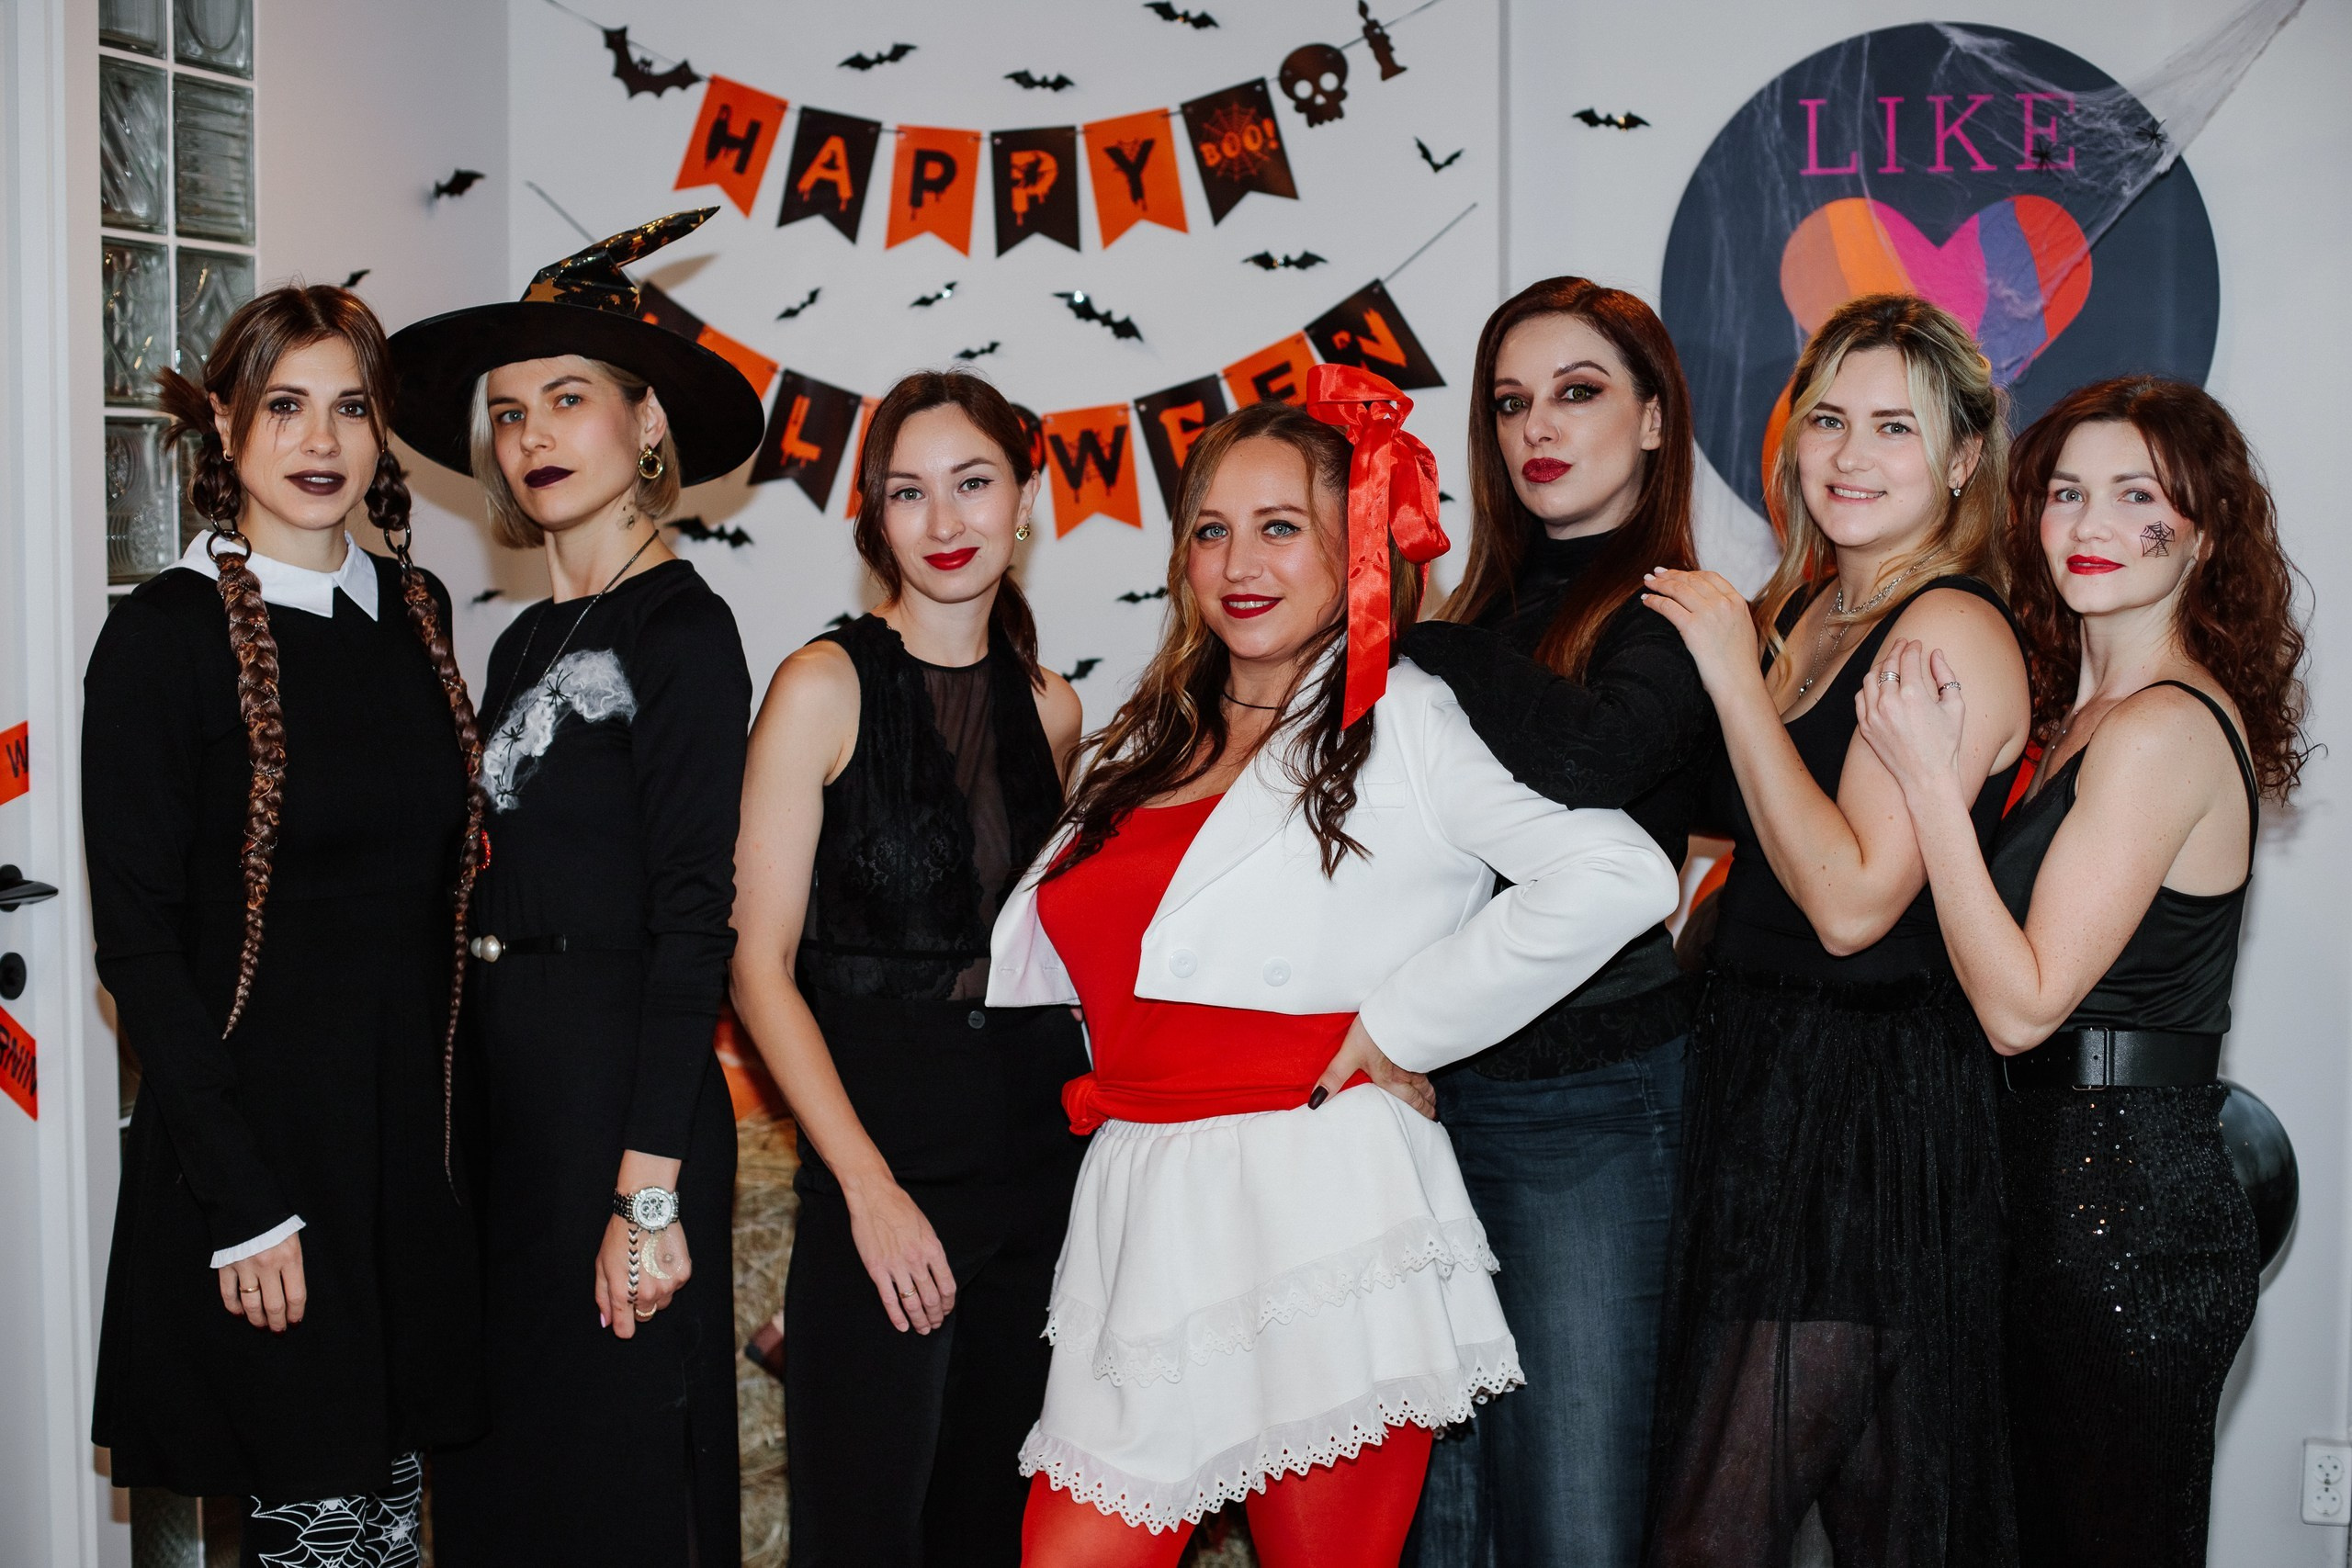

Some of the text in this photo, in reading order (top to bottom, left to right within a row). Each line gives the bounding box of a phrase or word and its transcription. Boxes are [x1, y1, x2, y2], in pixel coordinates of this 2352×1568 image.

[704, 103, 1279, 226] HAPPY BOO!
[1798, 92, 2076, 175] LIKE
[642, 307, 1408, 503] LWEEN
